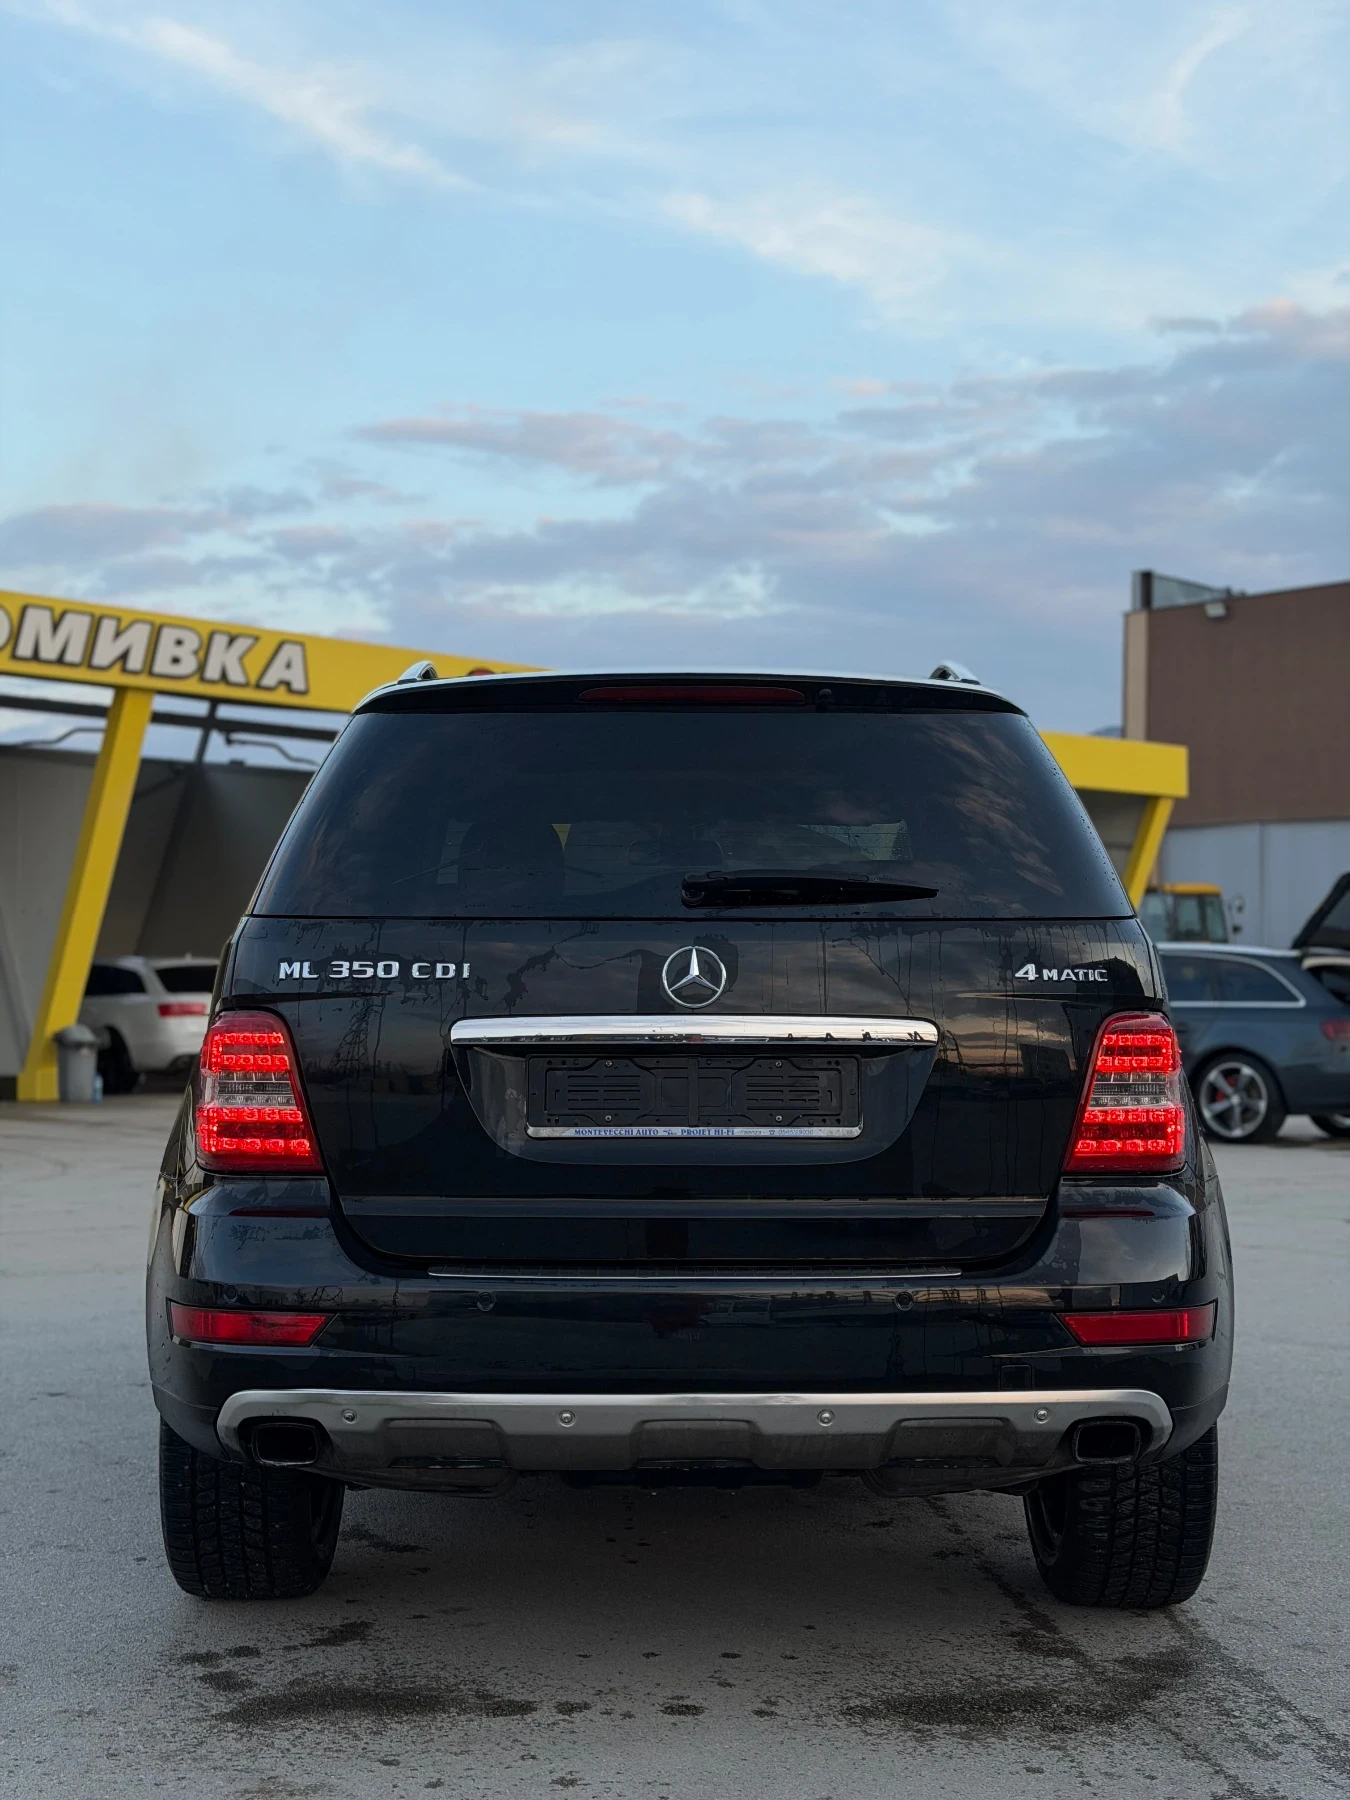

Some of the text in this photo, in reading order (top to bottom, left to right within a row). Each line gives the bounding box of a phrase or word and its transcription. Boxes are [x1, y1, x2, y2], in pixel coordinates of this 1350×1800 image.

[0, 604, 309, 694] МИВКА
[278, 961, 471, 980] ML 350 CDI
[574, 1128, 634, 1136] MONTEVECCHI
[636, 1128, 659, 1136] AUTO
